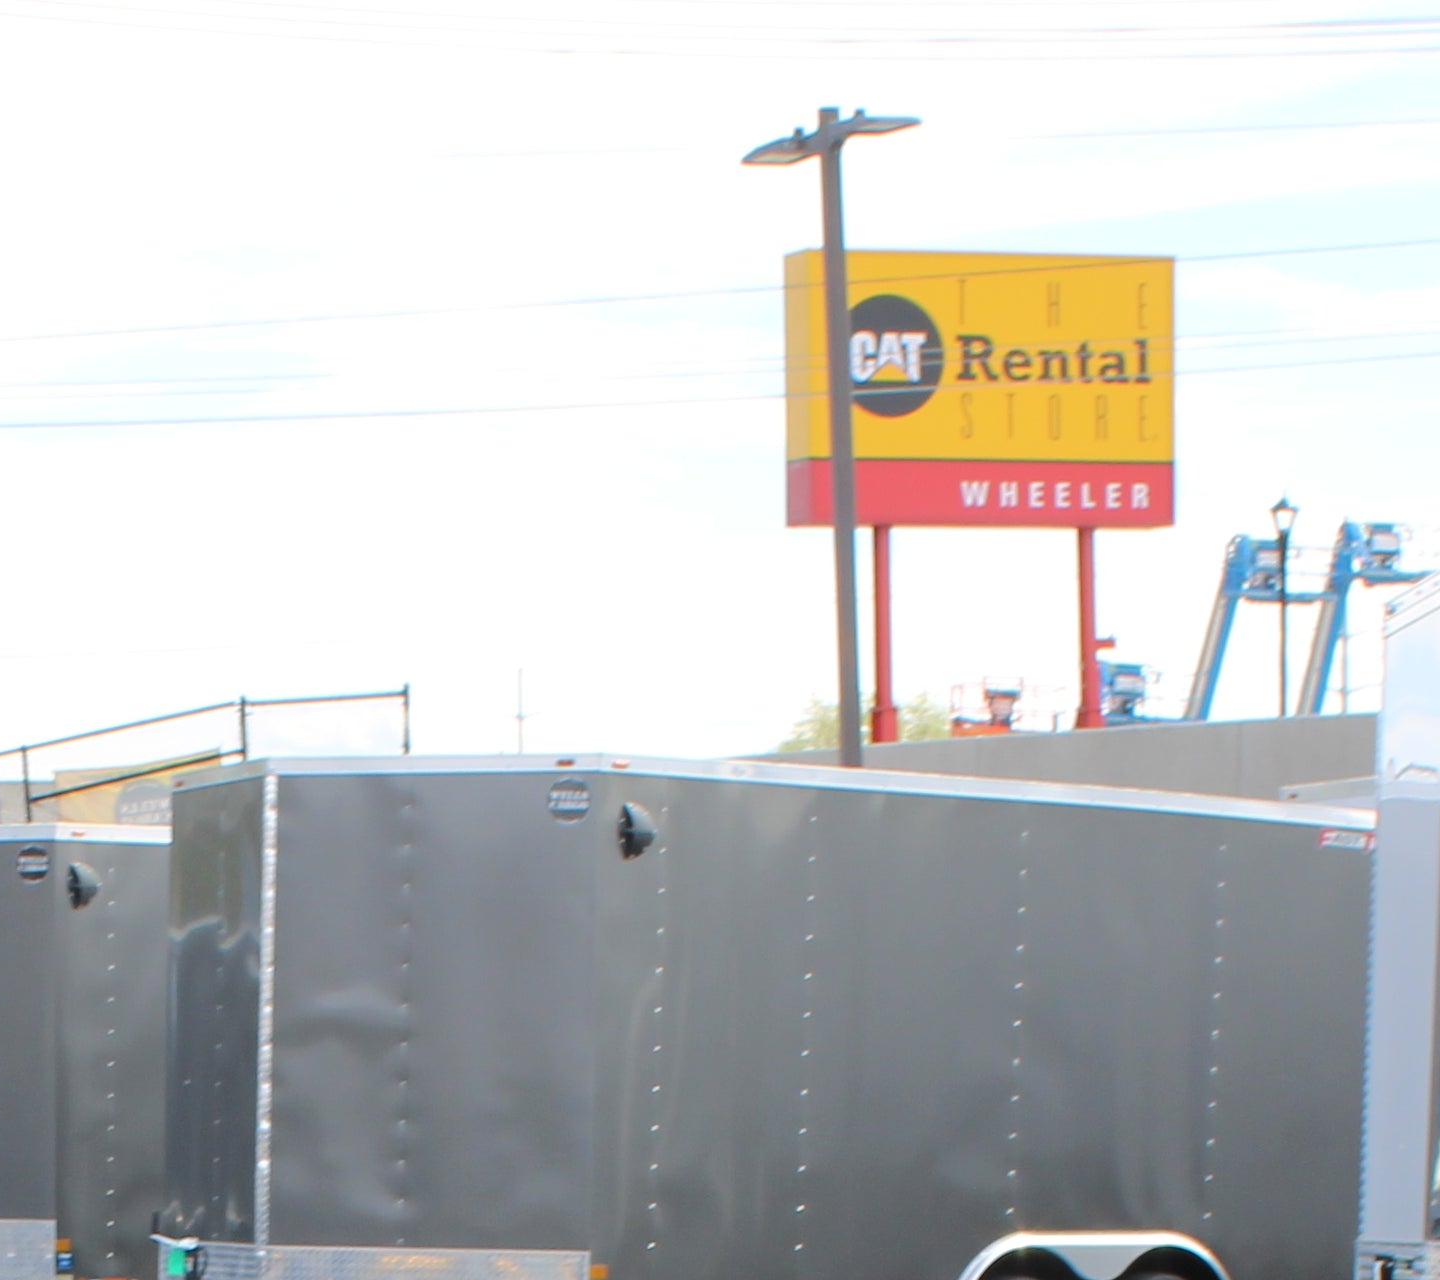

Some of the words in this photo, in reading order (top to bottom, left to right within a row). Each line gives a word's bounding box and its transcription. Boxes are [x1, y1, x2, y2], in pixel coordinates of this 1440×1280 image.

[850, 330, 927, 383] CAT
[956, 334, 1151, 383] Rental
[959, 480, 1151, 510] WHEELER
